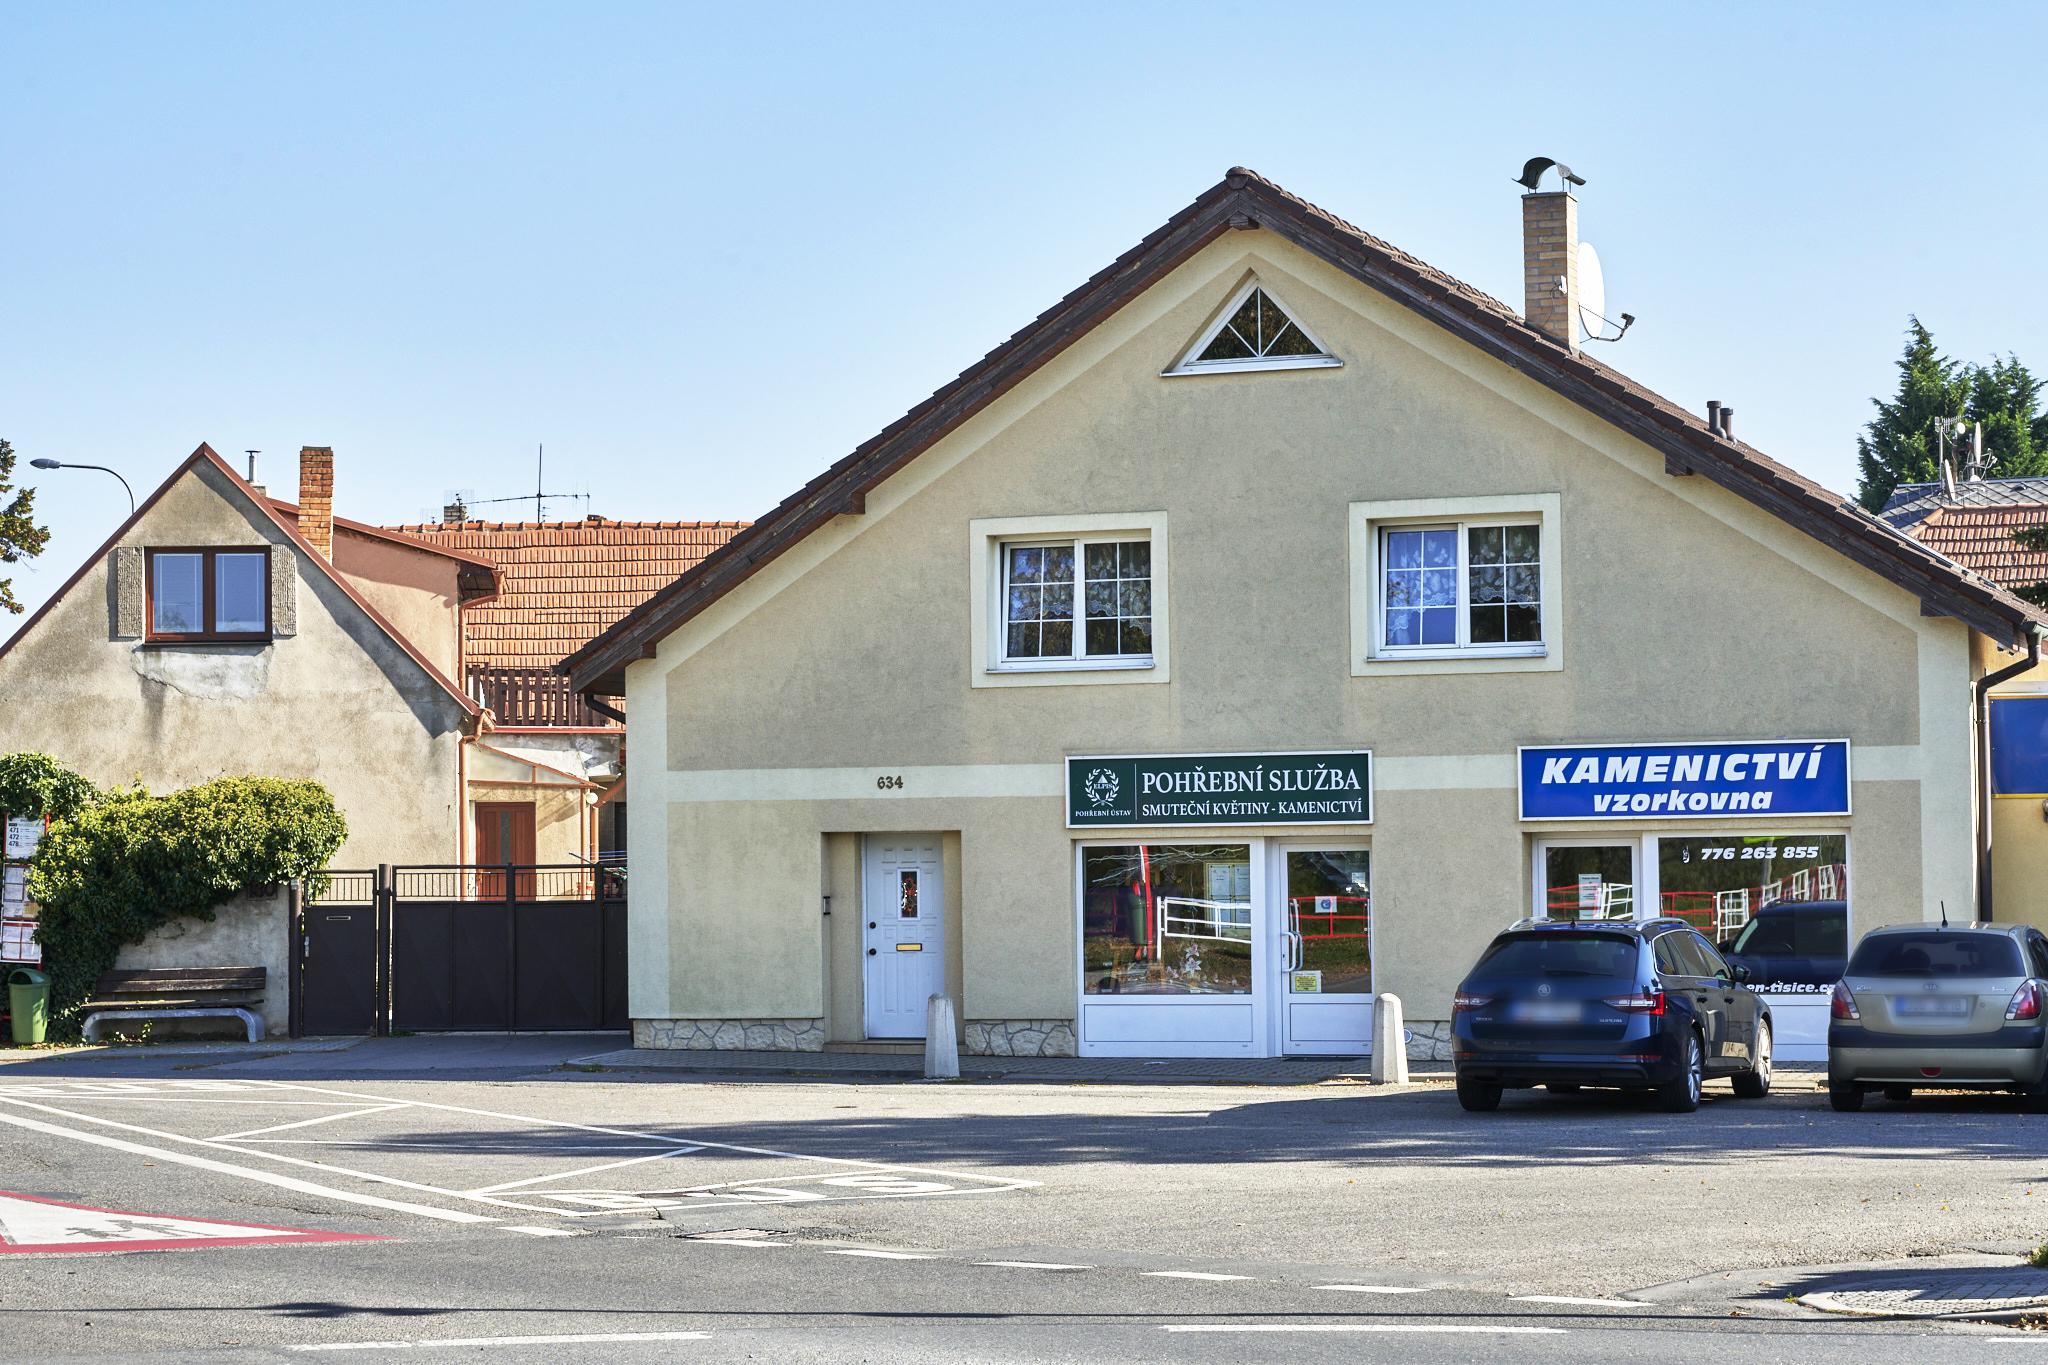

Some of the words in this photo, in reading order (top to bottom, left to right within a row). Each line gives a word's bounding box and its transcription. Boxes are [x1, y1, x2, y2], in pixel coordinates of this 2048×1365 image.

[1541, 745, 1826, 784] KAMENICTVÍ
[877, 775, 904, 790] 634
[1142, 765, 1264, 793] POHŘEBNÍ
[1269, 763, 1361, 791] SLUŽBA
[1142, 800, 1210, 816] SMUTEČNÍ
[1213, 800, 1270, 816] KVĚTINY
[1278, 798, 1363, 814] KAMENICTVÍ
[1593, 790, 1773, 812] vzorkovna
[1075, 809, 1109, 817] POHŘEBNÍ
[1110, 809, 1132, 817] ÚSTAV
[1701, 847, 1736, 860] 776
[1740, 847, 1778, 860] 263
[1782, 846, 1819, 859] 855
[1746, 982, 1836, 993] en-tisice.cz
[541, 1176, 955, 1208] BUS
